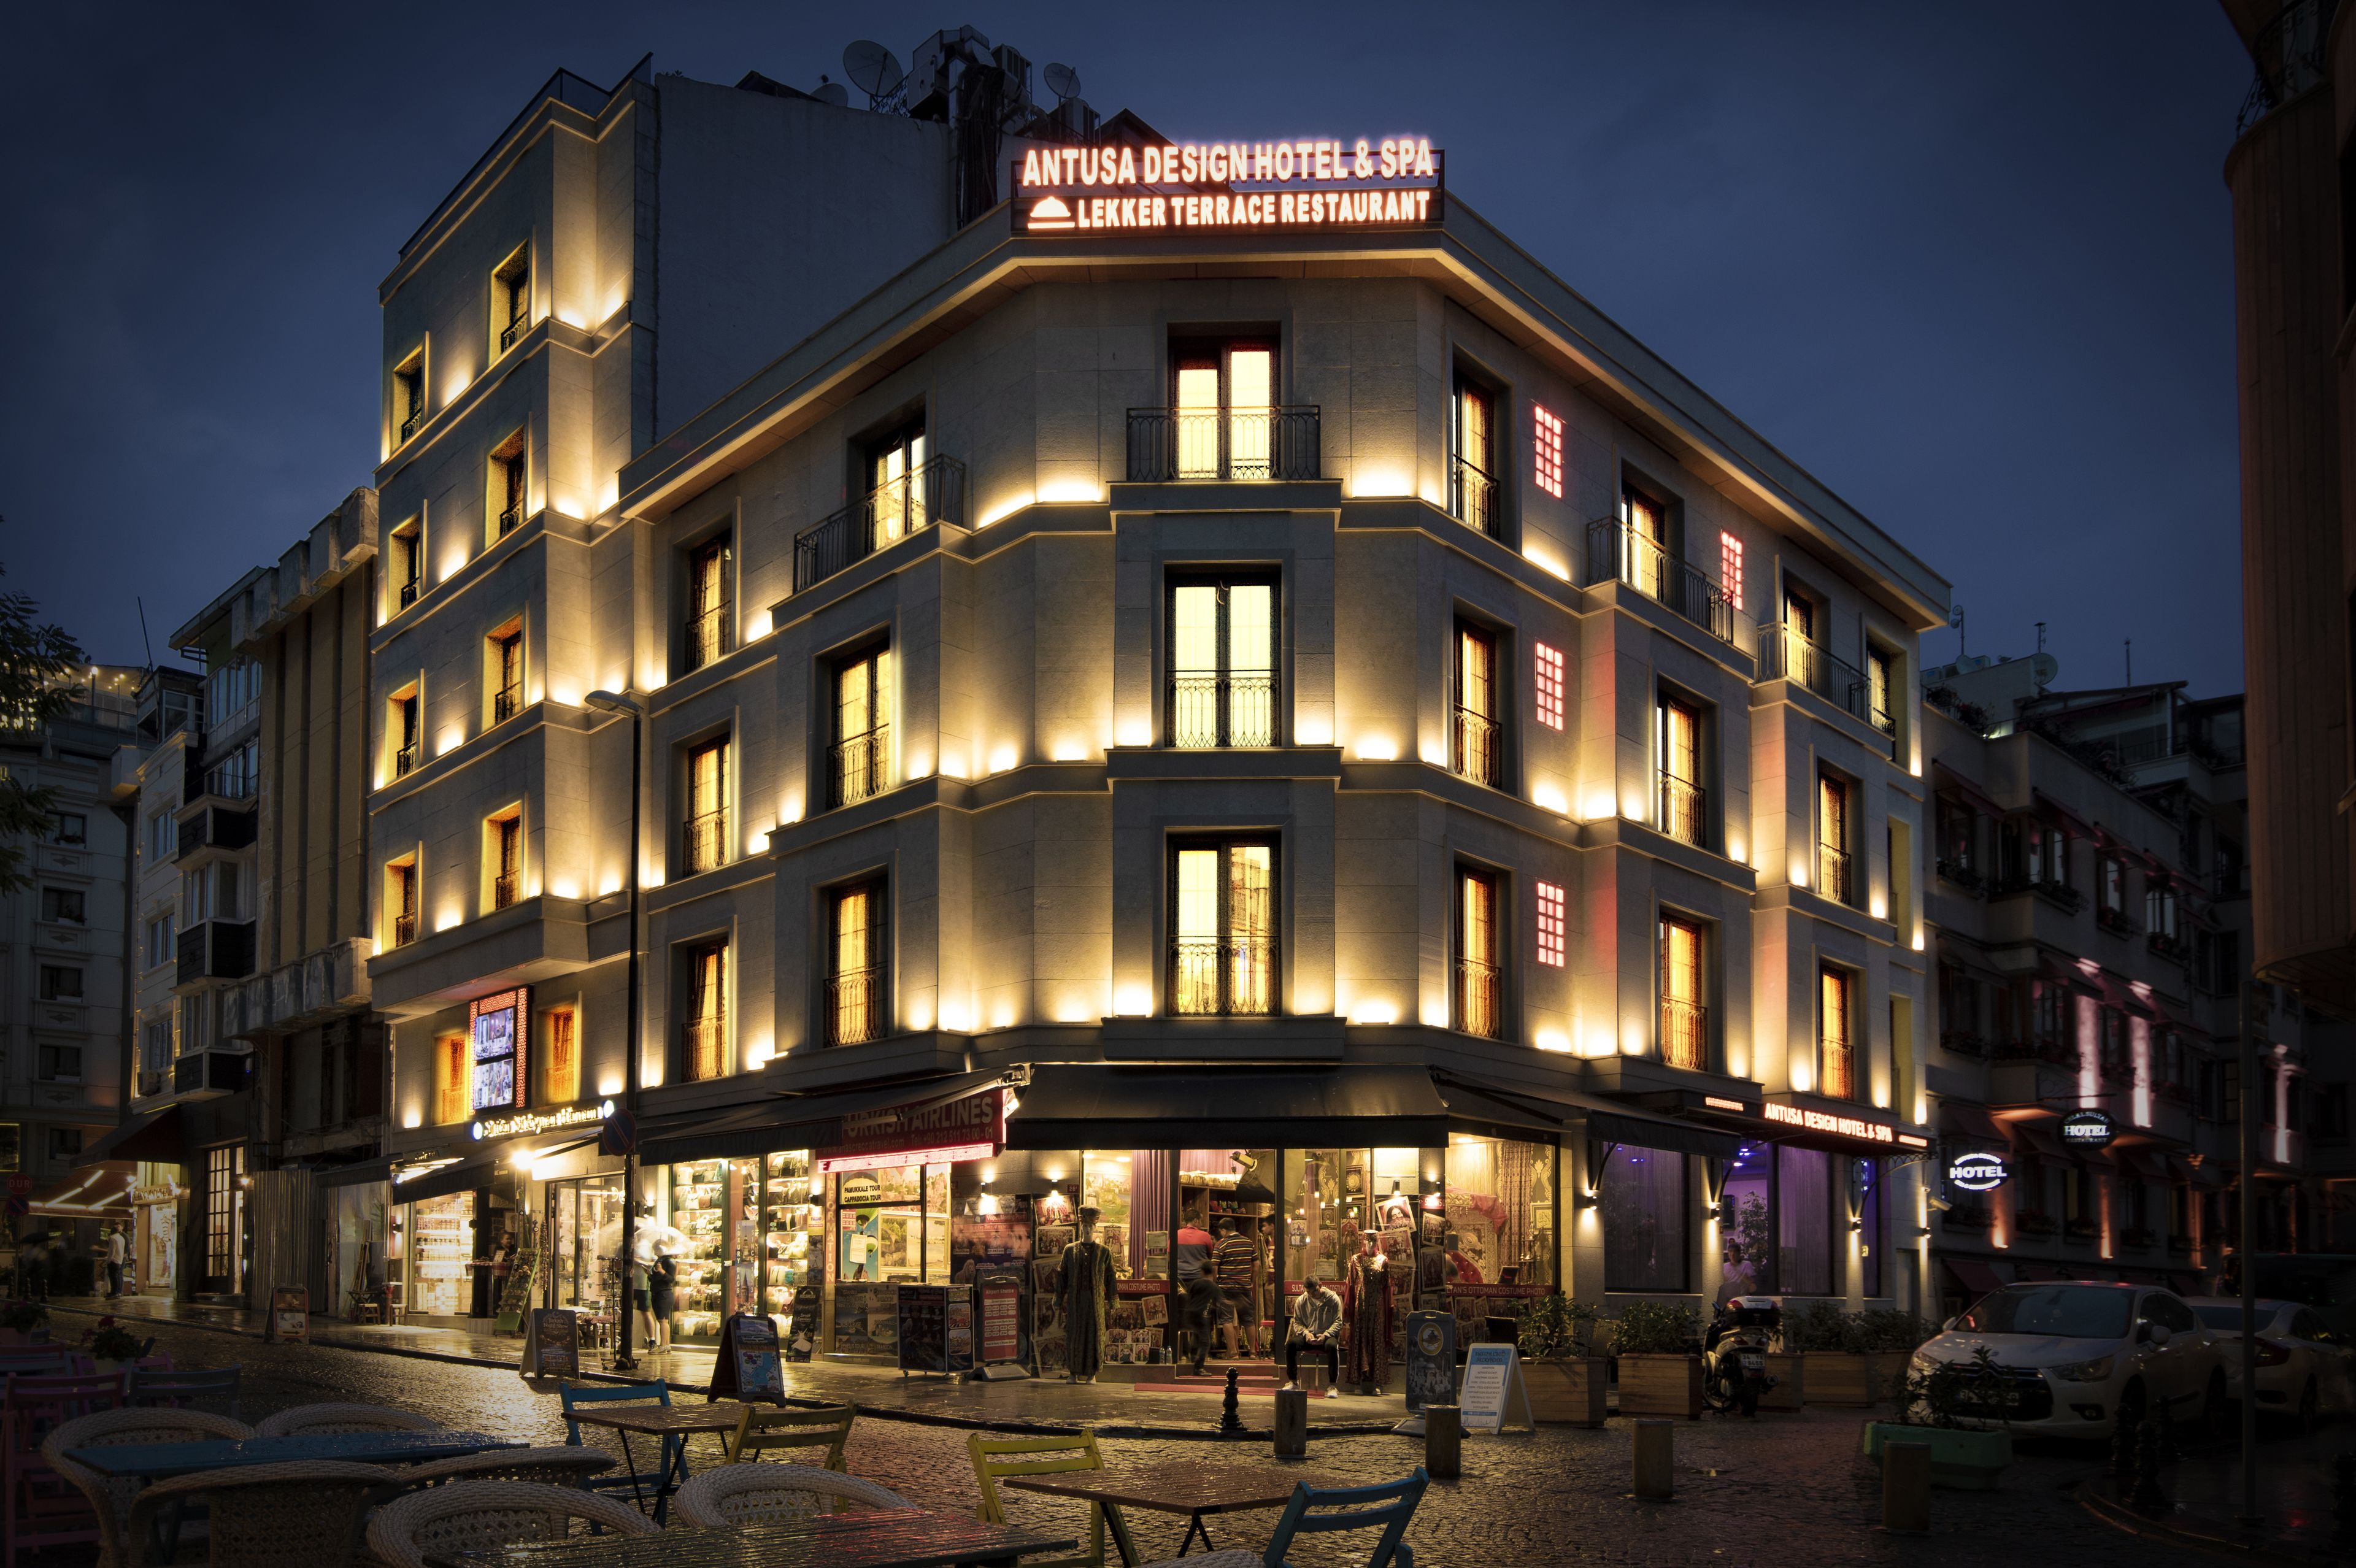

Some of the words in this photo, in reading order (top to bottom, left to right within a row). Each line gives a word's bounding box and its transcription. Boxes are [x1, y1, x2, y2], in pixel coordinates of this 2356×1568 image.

[1022, 147, 1137, 186] ANTUSA
[1144, 144, 1247, 184] DESIGN
[1255, 141, 1348, 182] HOTEL
[1353, 140, 1375, 179] &
[1380, 139, 1434, 179] SPA
[1079, 198, 1166, 228] LEKKER
[1171, 194, 1276, 226] TERRACE
[1282, 191, 1430, 223] RESTAURANT
[911, 1095, 993, 1132] AIRLINES
[1765, 1102, 1804, 1126] ANTUSA
[1804, 1110, 1838, 1133] DESIGN
[1838, 1117, 1868, 1138] HOTEL
[1868, 1124, 1874, 1139] &
[1875, 1124, 1893, 1142] SPA
[972, 1127, 980, 1140] 00
[985, 1126, 993, 1139] 01
[2063, 1124, 2111, 1137] HOTEL
[9, 1179, 30, 1188] DUR
[1949, 1166, 2008, 1178] HOTEL
[827, 1172, 836, 1282] INFORMATION
[1148, 1283, 1160, 1291] PHOTO
